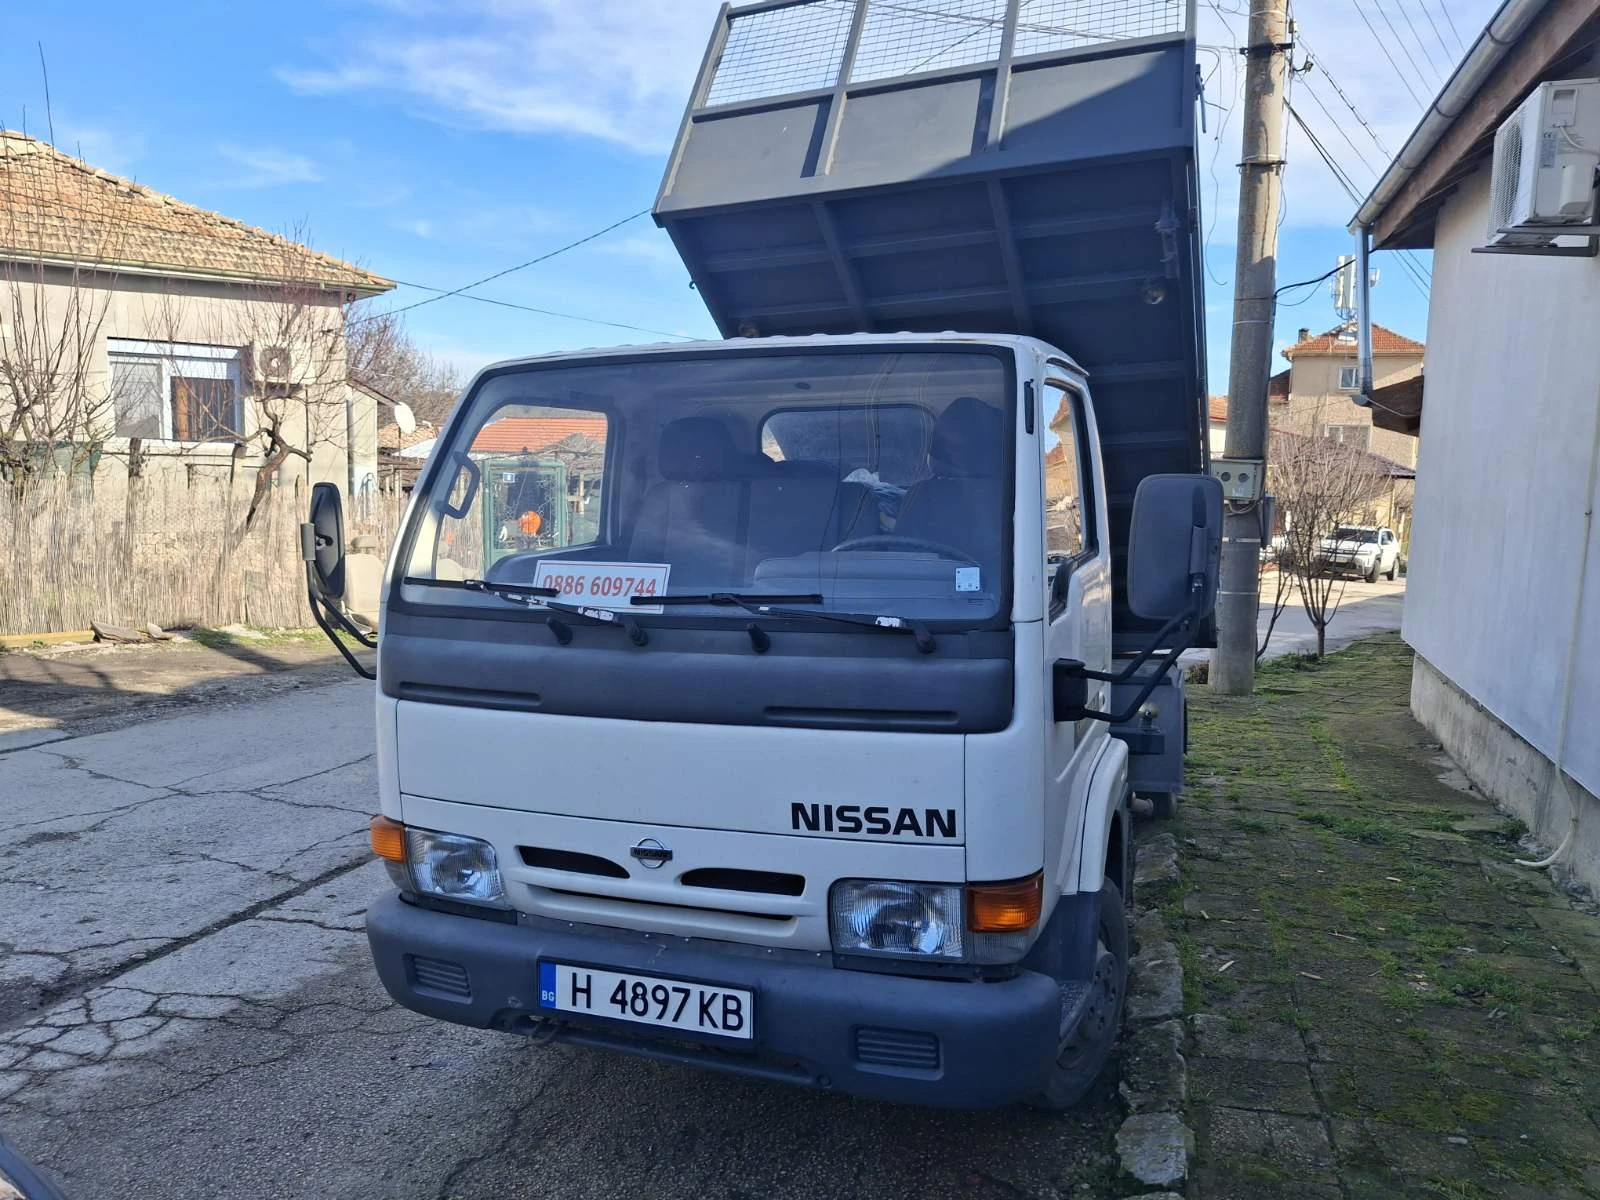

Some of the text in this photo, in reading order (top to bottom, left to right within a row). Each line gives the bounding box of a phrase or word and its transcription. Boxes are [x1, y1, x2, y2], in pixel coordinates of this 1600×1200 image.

[543, 574, 657, 597] 0886 609744
[791, 802, 957, 838] NISSAN
[541, 990, 555, 1002] BG
[571, 972, 592, 1009] H
